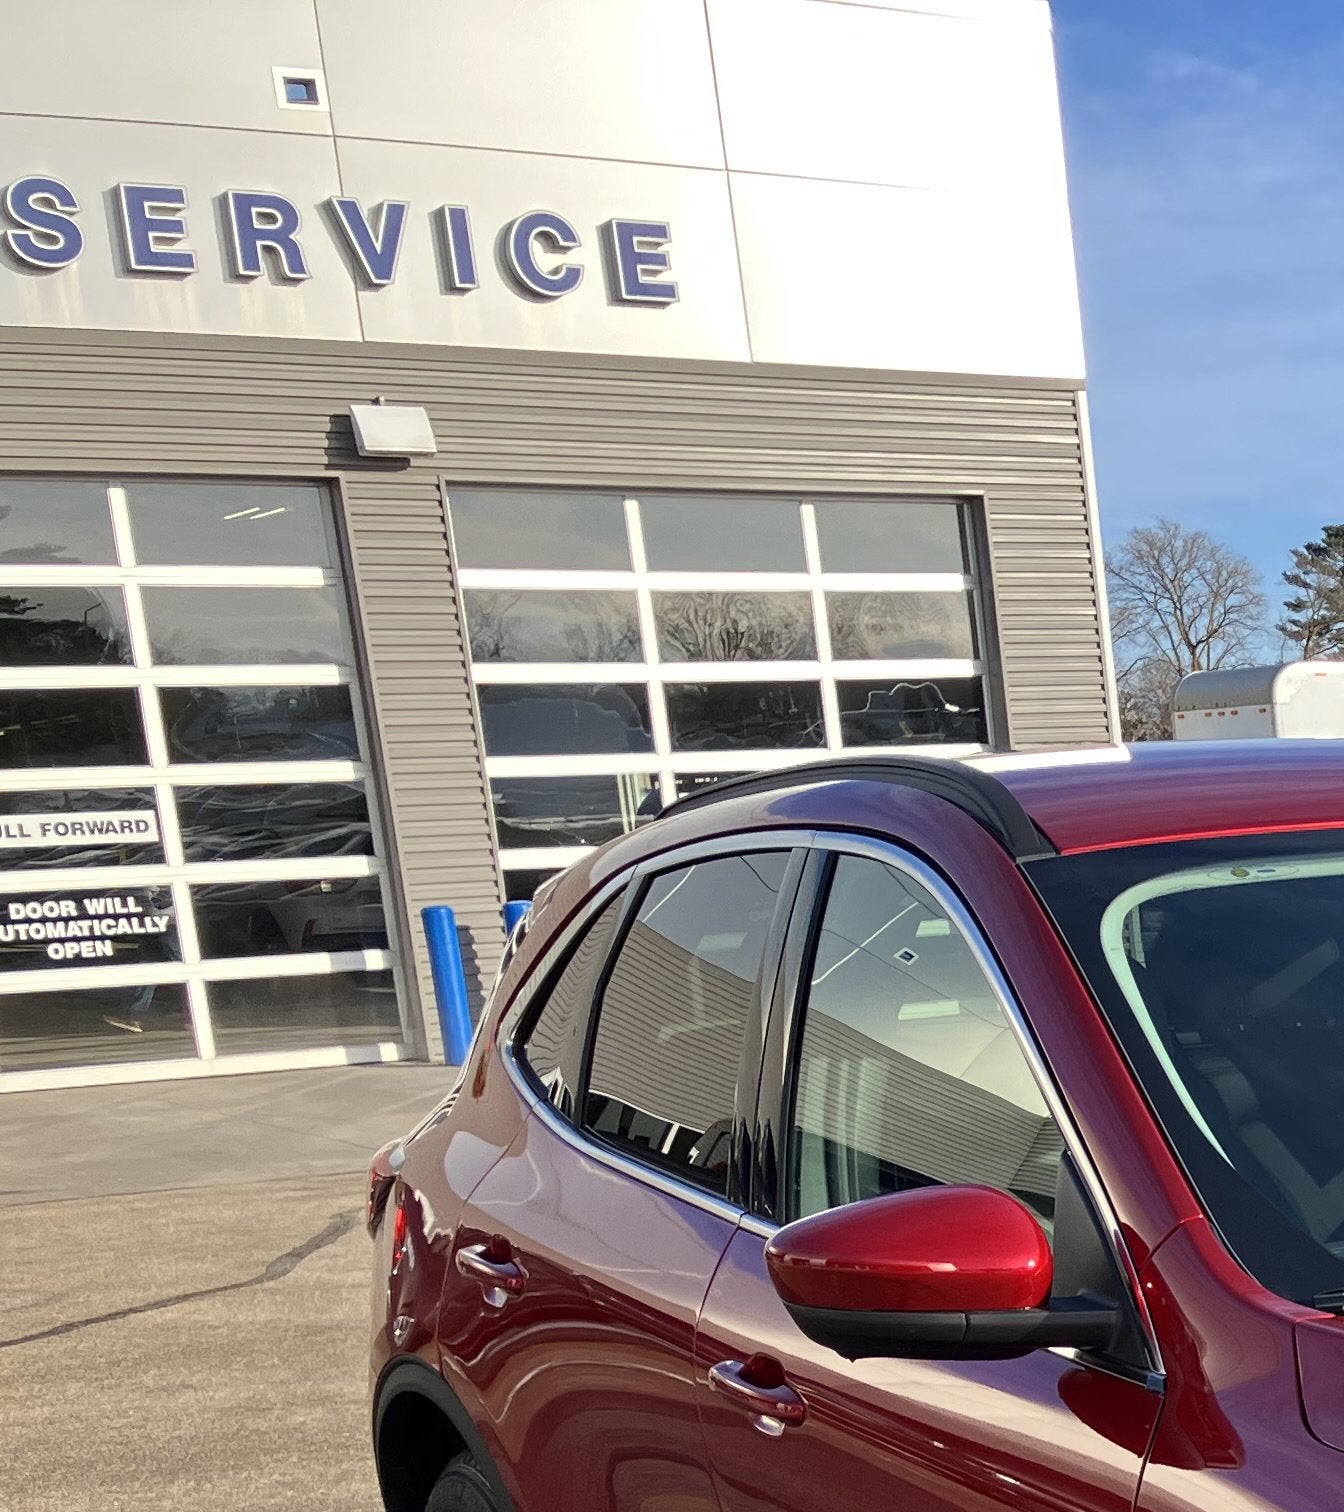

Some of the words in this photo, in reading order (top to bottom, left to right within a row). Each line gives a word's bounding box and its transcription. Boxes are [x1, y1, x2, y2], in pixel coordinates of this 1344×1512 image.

[4, 174, 680, 306] SERVICE
[40, 818, 150, 838] FORWARD
[8, 899, 78, 920] DOOR
[83, 896, 143, 916] WILL
[0, 915, 170, 942] UTOMATICALLY
[47, 939, 114, 960] OPEN
